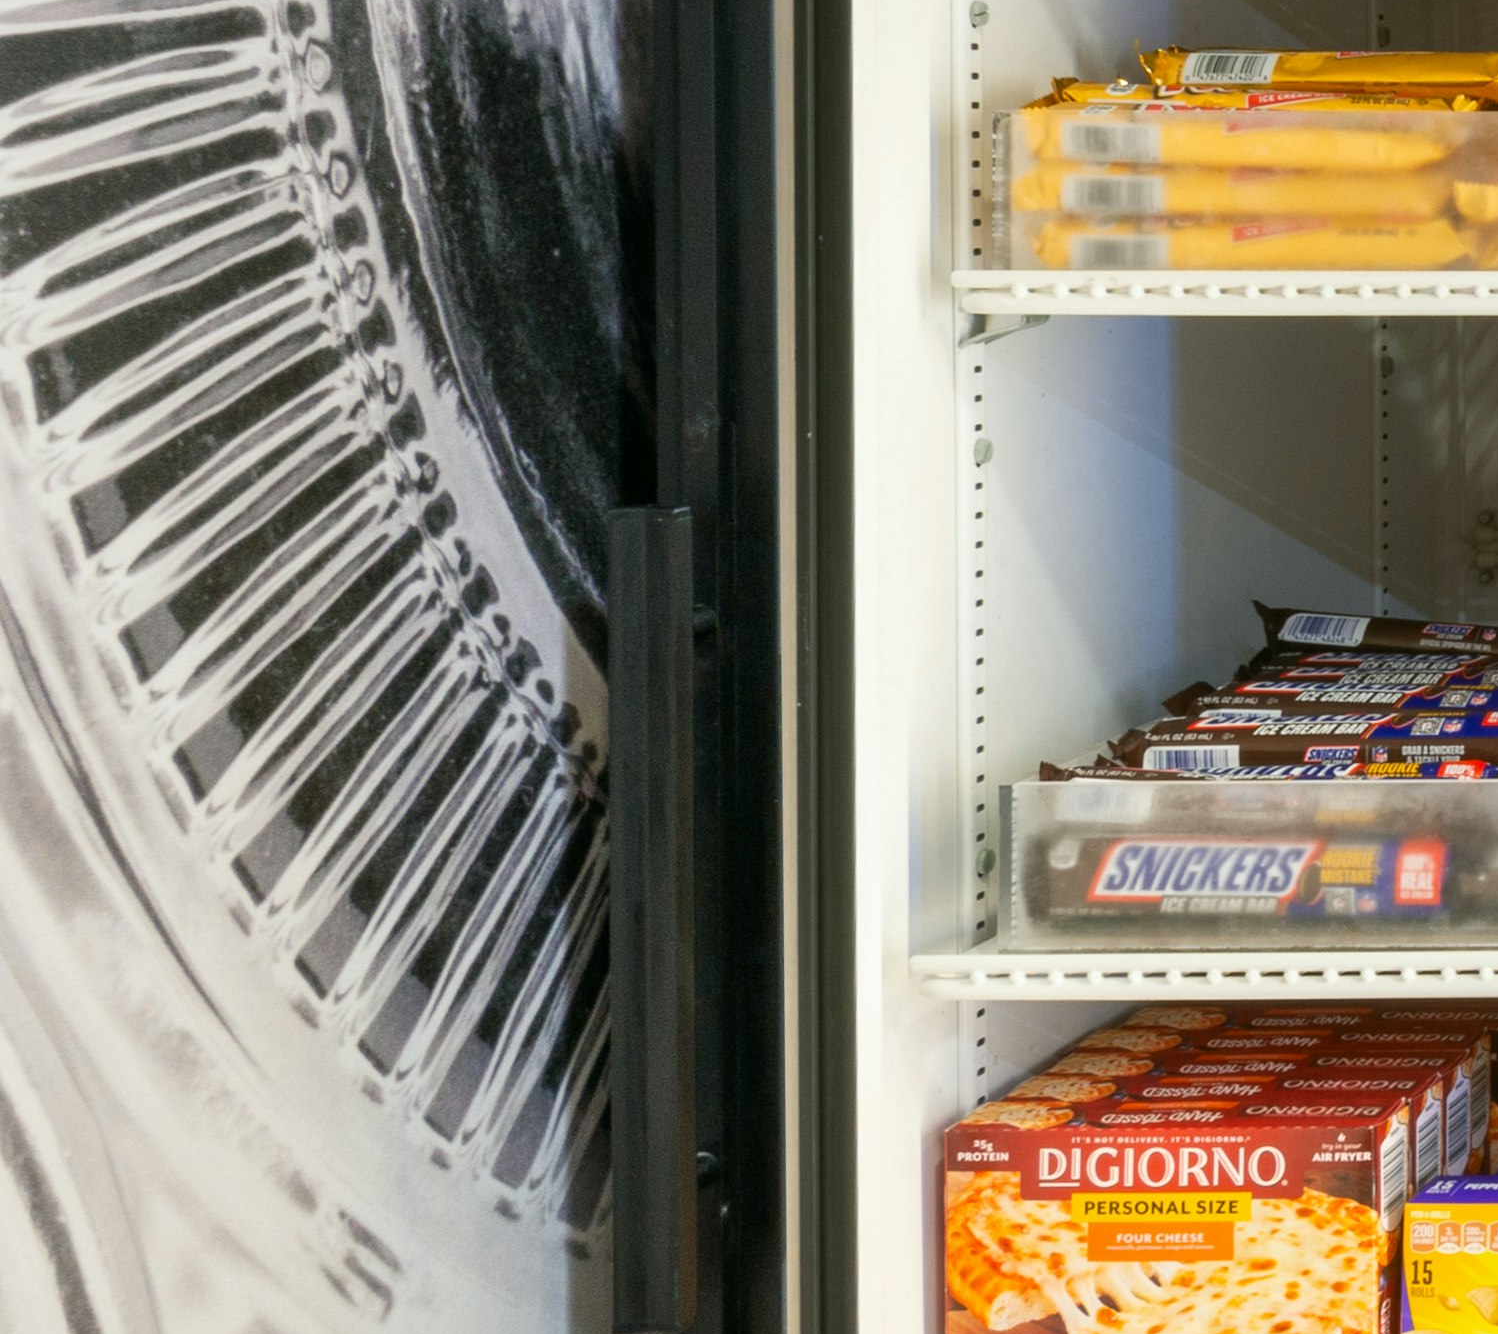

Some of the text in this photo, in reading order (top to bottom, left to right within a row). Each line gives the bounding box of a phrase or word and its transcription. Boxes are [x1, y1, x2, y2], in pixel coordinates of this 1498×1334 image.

[1253, 722, 1367, 736] ICE CREAM BAR
[1104, 844, 1306, 892] SNICKERS
[957, 1151, 1009, 1163] PROTEIN
[1312, 1151, 1371, 1162] AIR FRYER
[1084, 1200, 1239, 1215] PERSONAL SIZE
[1116, 1233, 1205, 1243] FOUR CHEESE
[1411, 1260, 1433, 1286] 15
[1411, 1286, 1435, 1298] ROLLS
